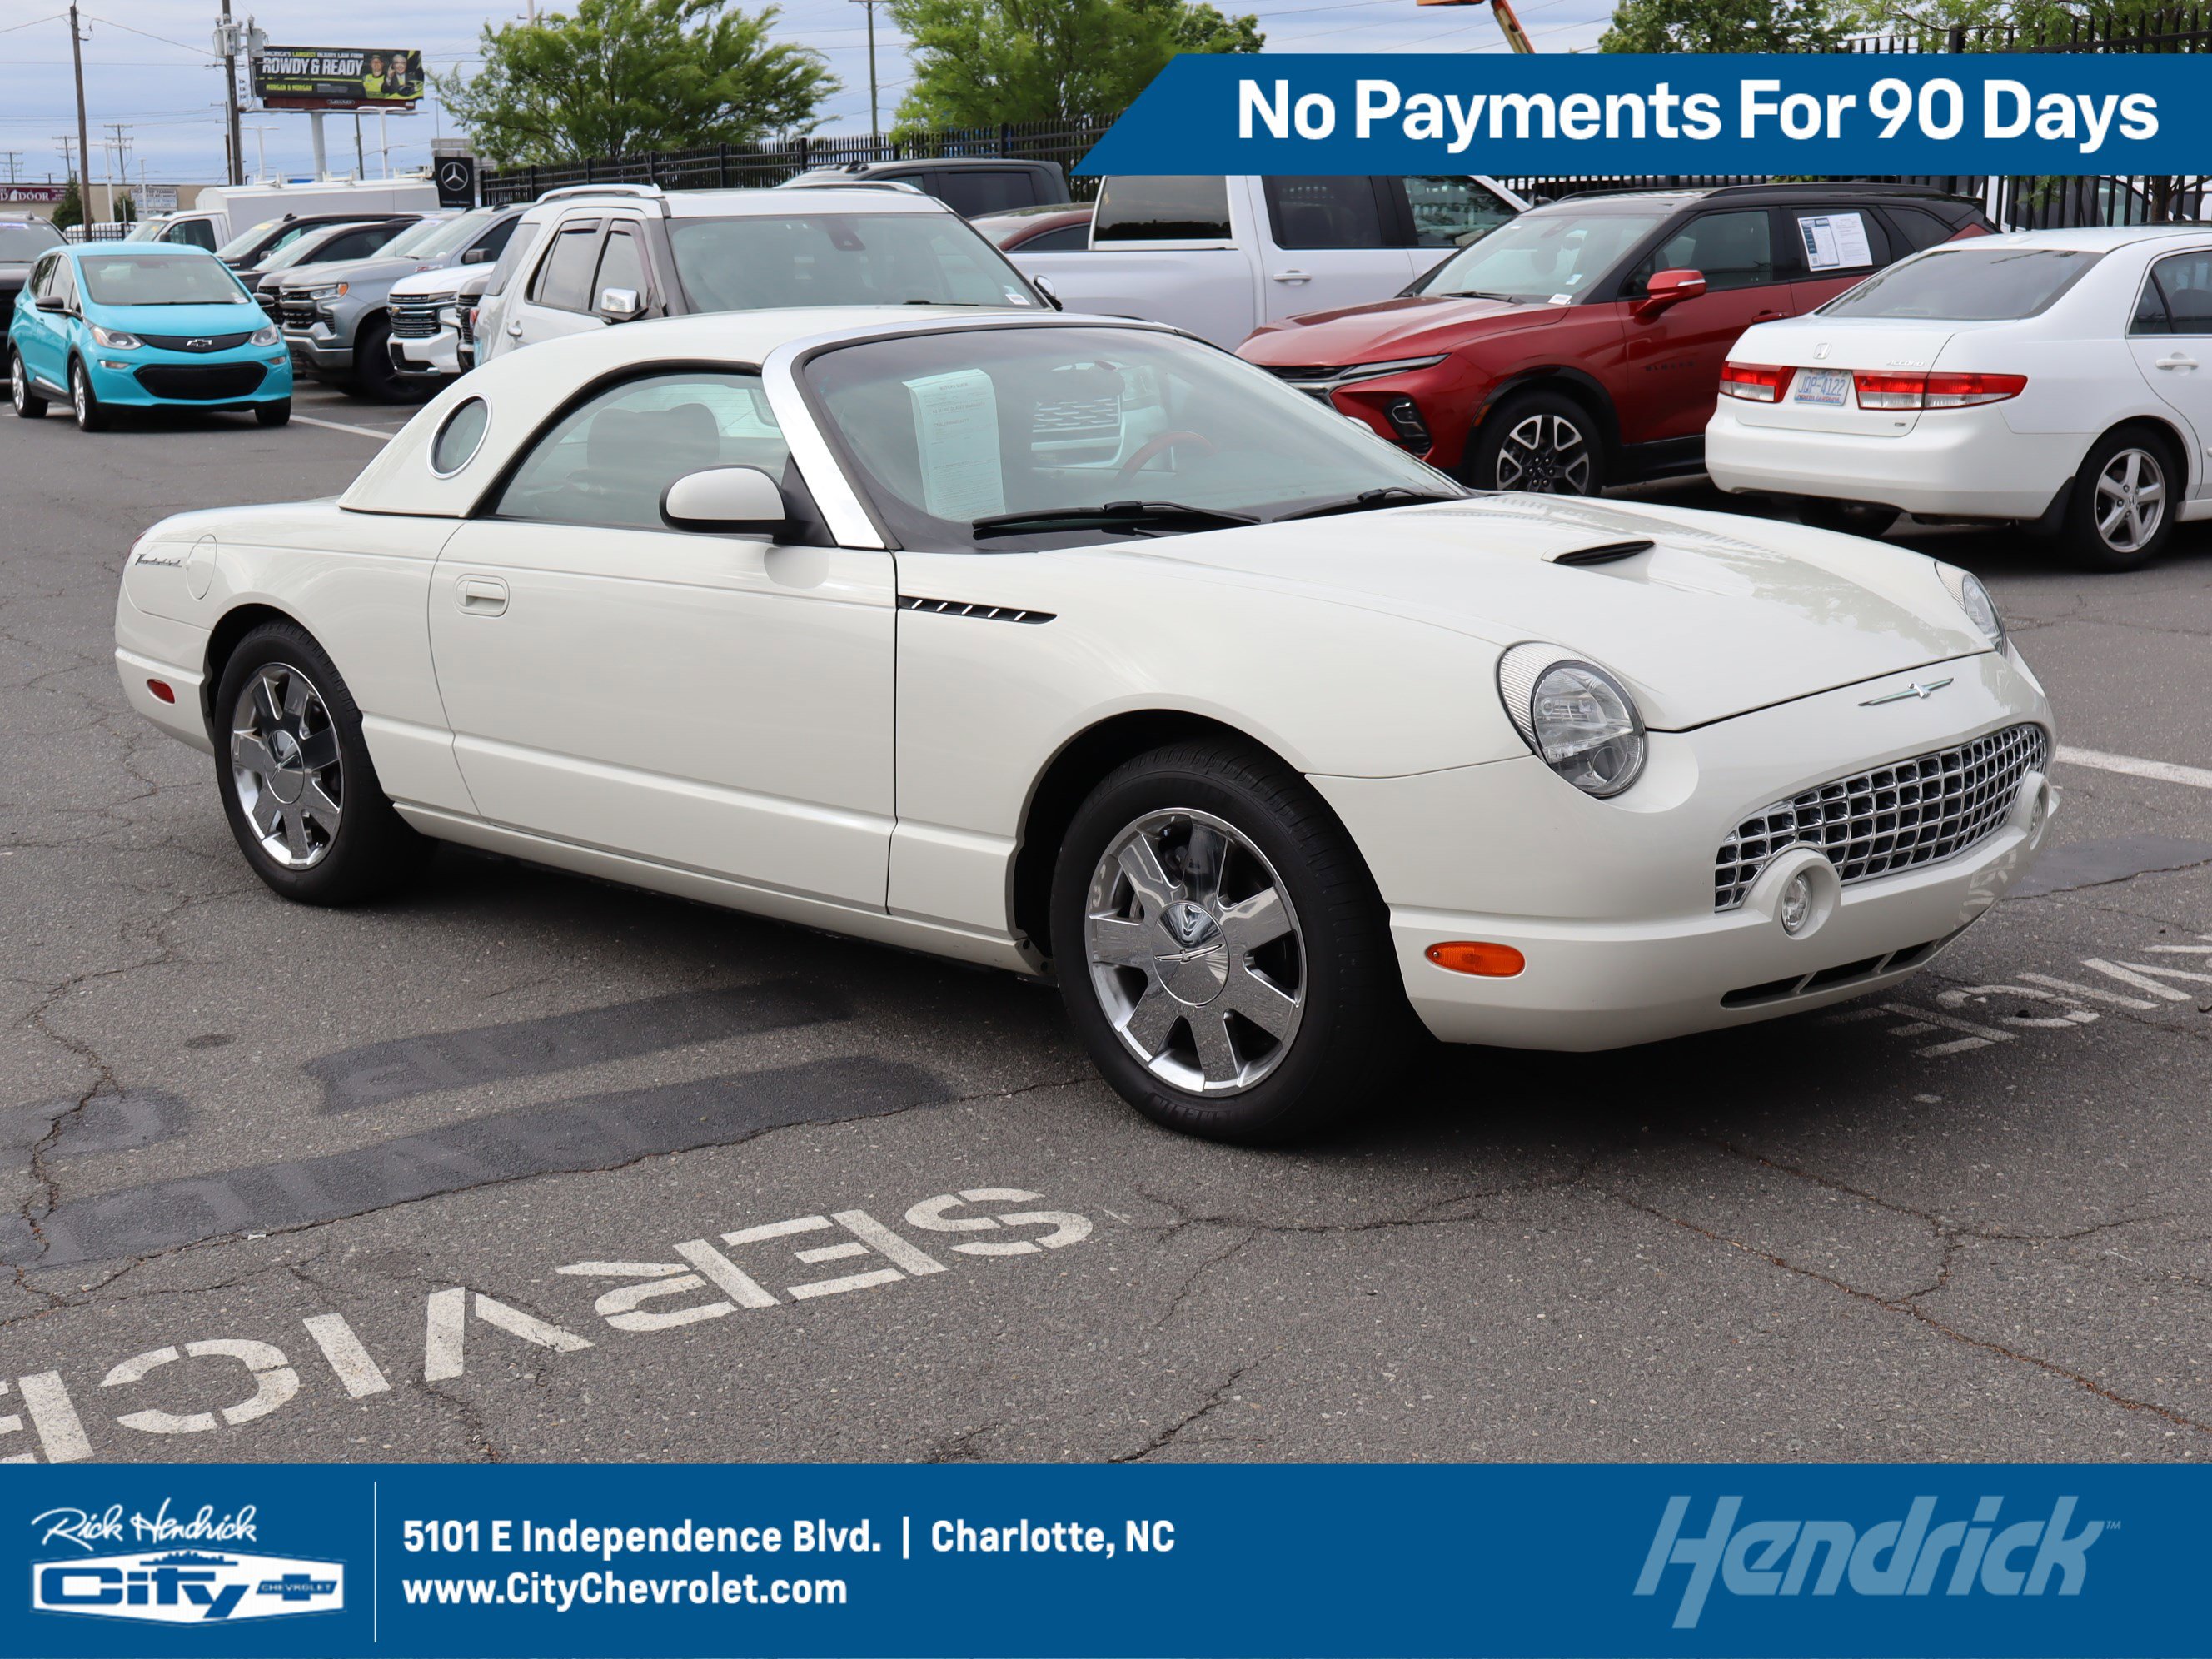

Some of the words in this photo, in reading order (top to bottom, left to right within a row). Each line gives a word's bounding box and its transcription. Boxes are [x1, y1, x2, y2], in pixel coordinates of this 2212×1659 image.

[262, 57, 309, 74] ROWDY
[311, 59, 321, 75] &
[322, 59, 364, 76] READY
[18, 192, 49, 201] DOOR
